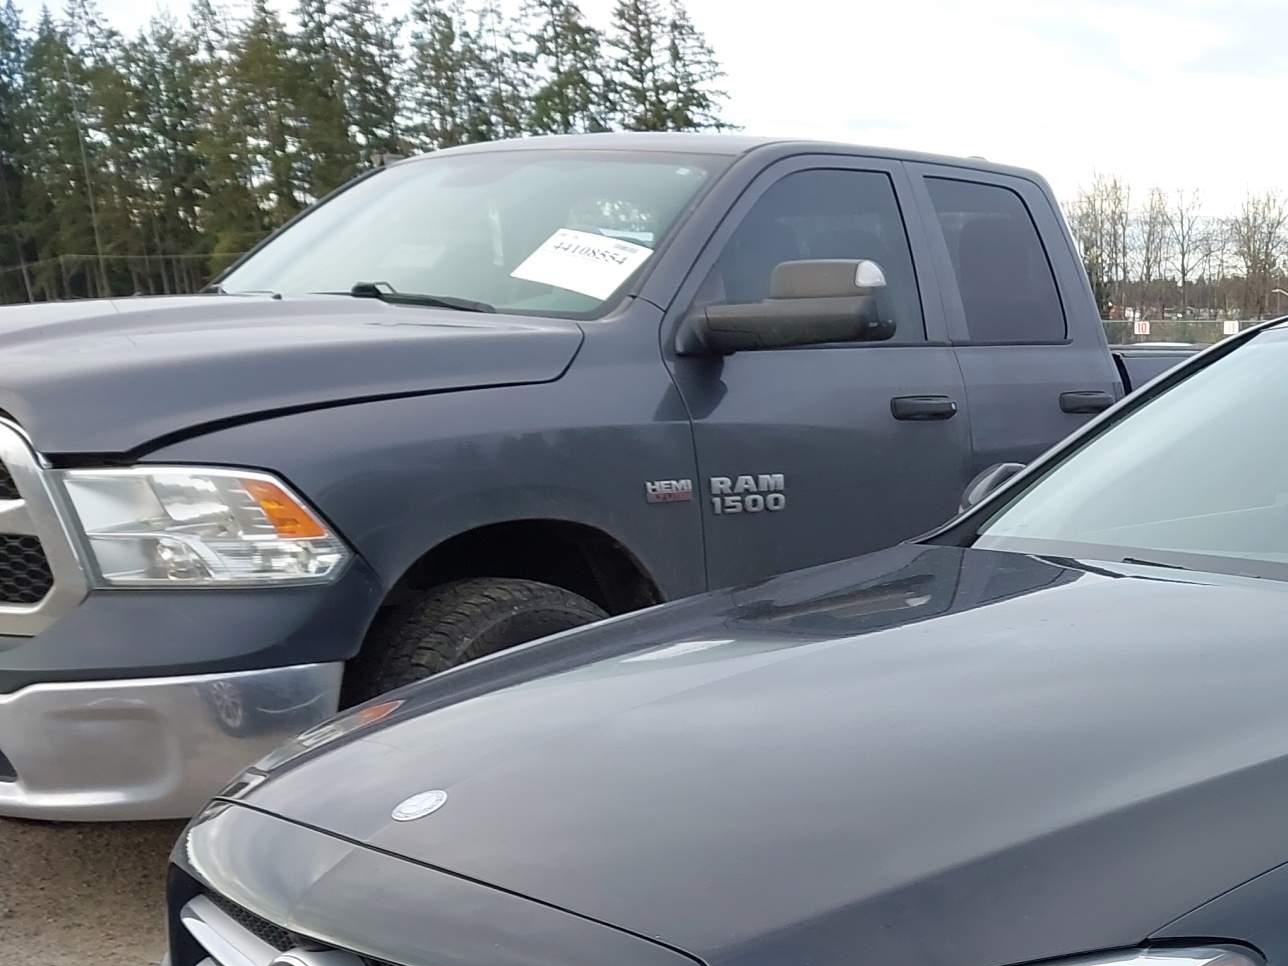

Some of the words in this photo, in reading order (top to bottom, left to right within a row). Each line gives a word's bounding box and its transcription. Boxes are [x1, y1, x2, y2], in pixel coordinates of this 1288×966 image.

[646, 480, 693, 493] HEMI
[710, 474, 785, 494] RAM
[711, 493, 786, 514] 1500
